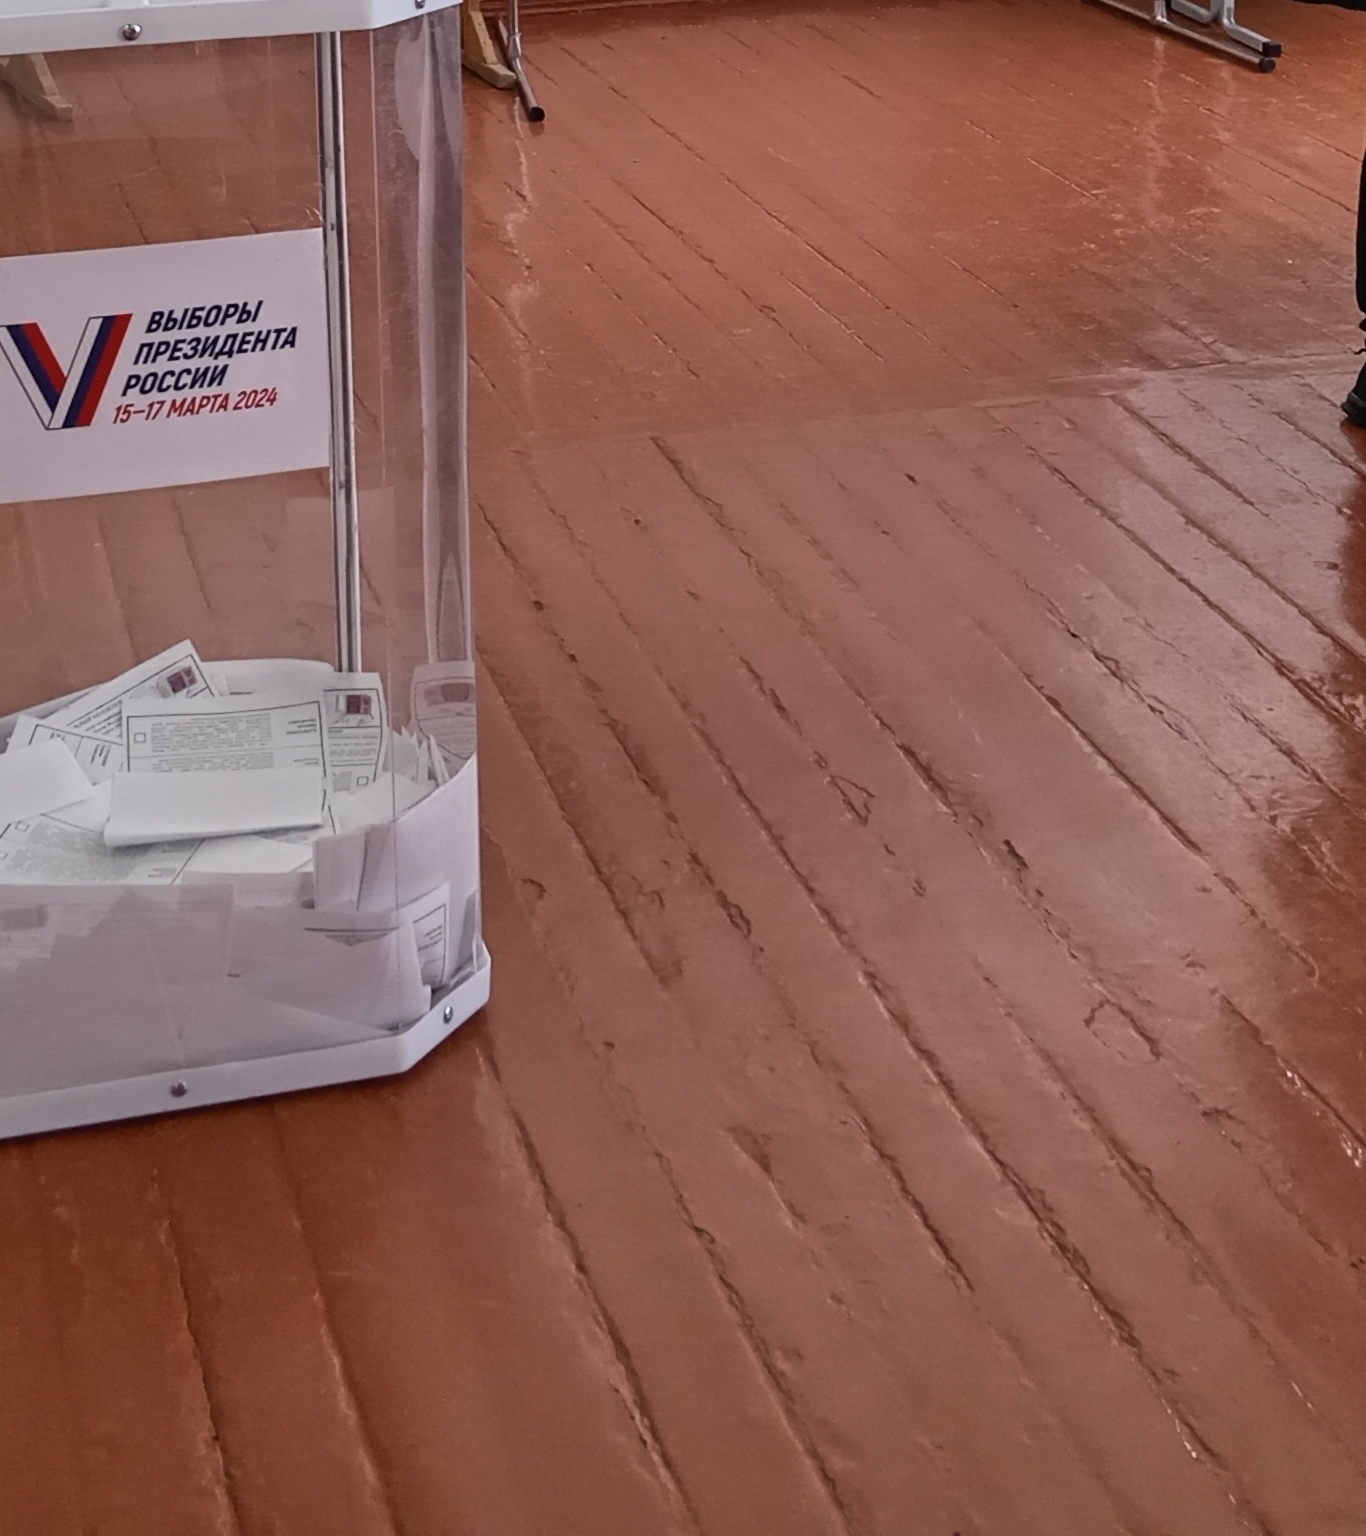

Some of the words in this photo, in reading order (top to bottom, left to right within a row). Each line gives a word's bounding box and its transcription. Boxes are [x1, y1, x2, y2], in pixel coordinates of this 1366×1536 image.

[145, 300, 264, 334] ВЫБОРЫ
[133, 326, 298, 365] ПРЕЗИДЕНТА
[121, 364, 230, 397] РОССИИ
[166, 394, 230, 418] МАРТА
[233, 387, 278, 411] 2024
